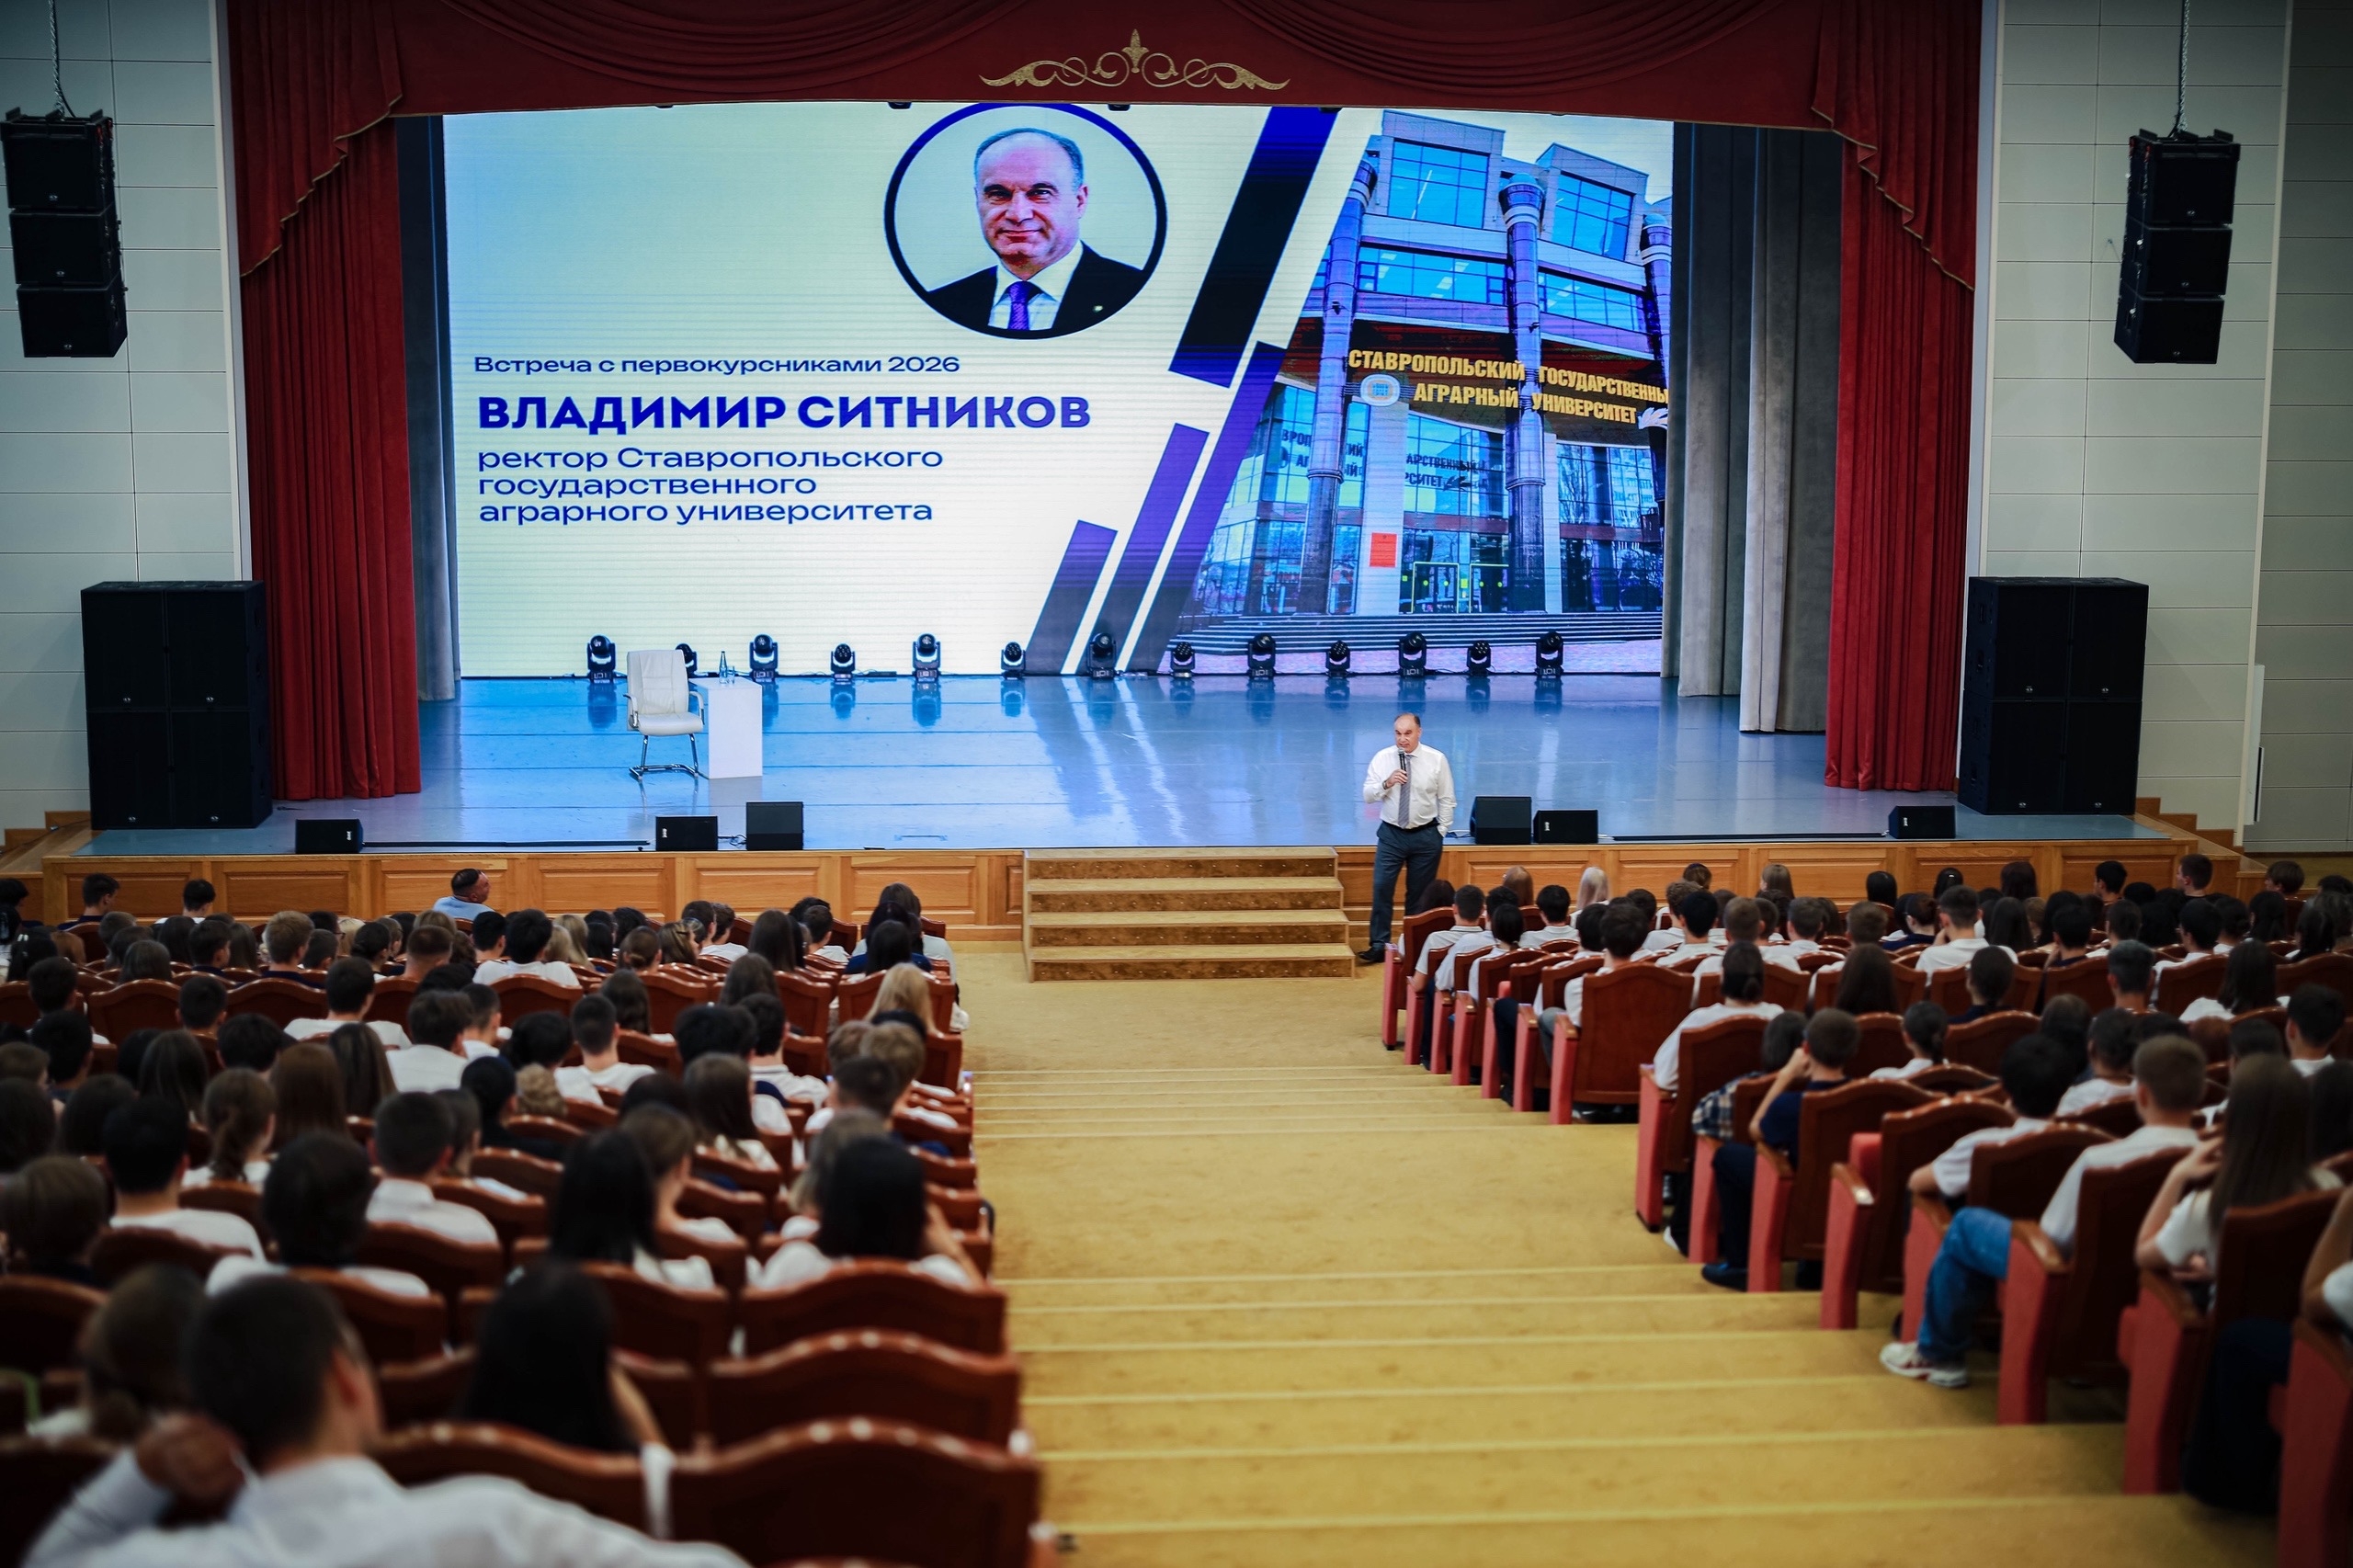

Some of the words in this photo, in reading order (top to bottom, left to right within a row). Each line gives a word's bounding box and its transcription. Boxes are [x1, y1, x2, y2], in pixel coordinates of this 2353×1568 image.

[473, 356, 593, 376] Встреча
[597, 359, 616, 373] с
[621, 359, 882, 376] первокурсниками
[888, 356, 961, 373] 2026
[1348, 349, 1526, 381] СТАВРОПОЛЬСКИЙ
[478, 396, 788, 436] ВЛАДИМИР
[797, 395, 1091, 429] СИТНИКОВ
[1414, 382, 1518, 408] АГРАРНЫЙ
[1532, 392, 1636, 424] УНИВЕРСИТЕТ
[478, 451, 608, 472] ректор
[617, 447, 943, 472] Ставропольского
[479, 478, 817, 499] государственного
[479, 505, 668, 526] аграрного
[676, 505, 932, 526] университета
